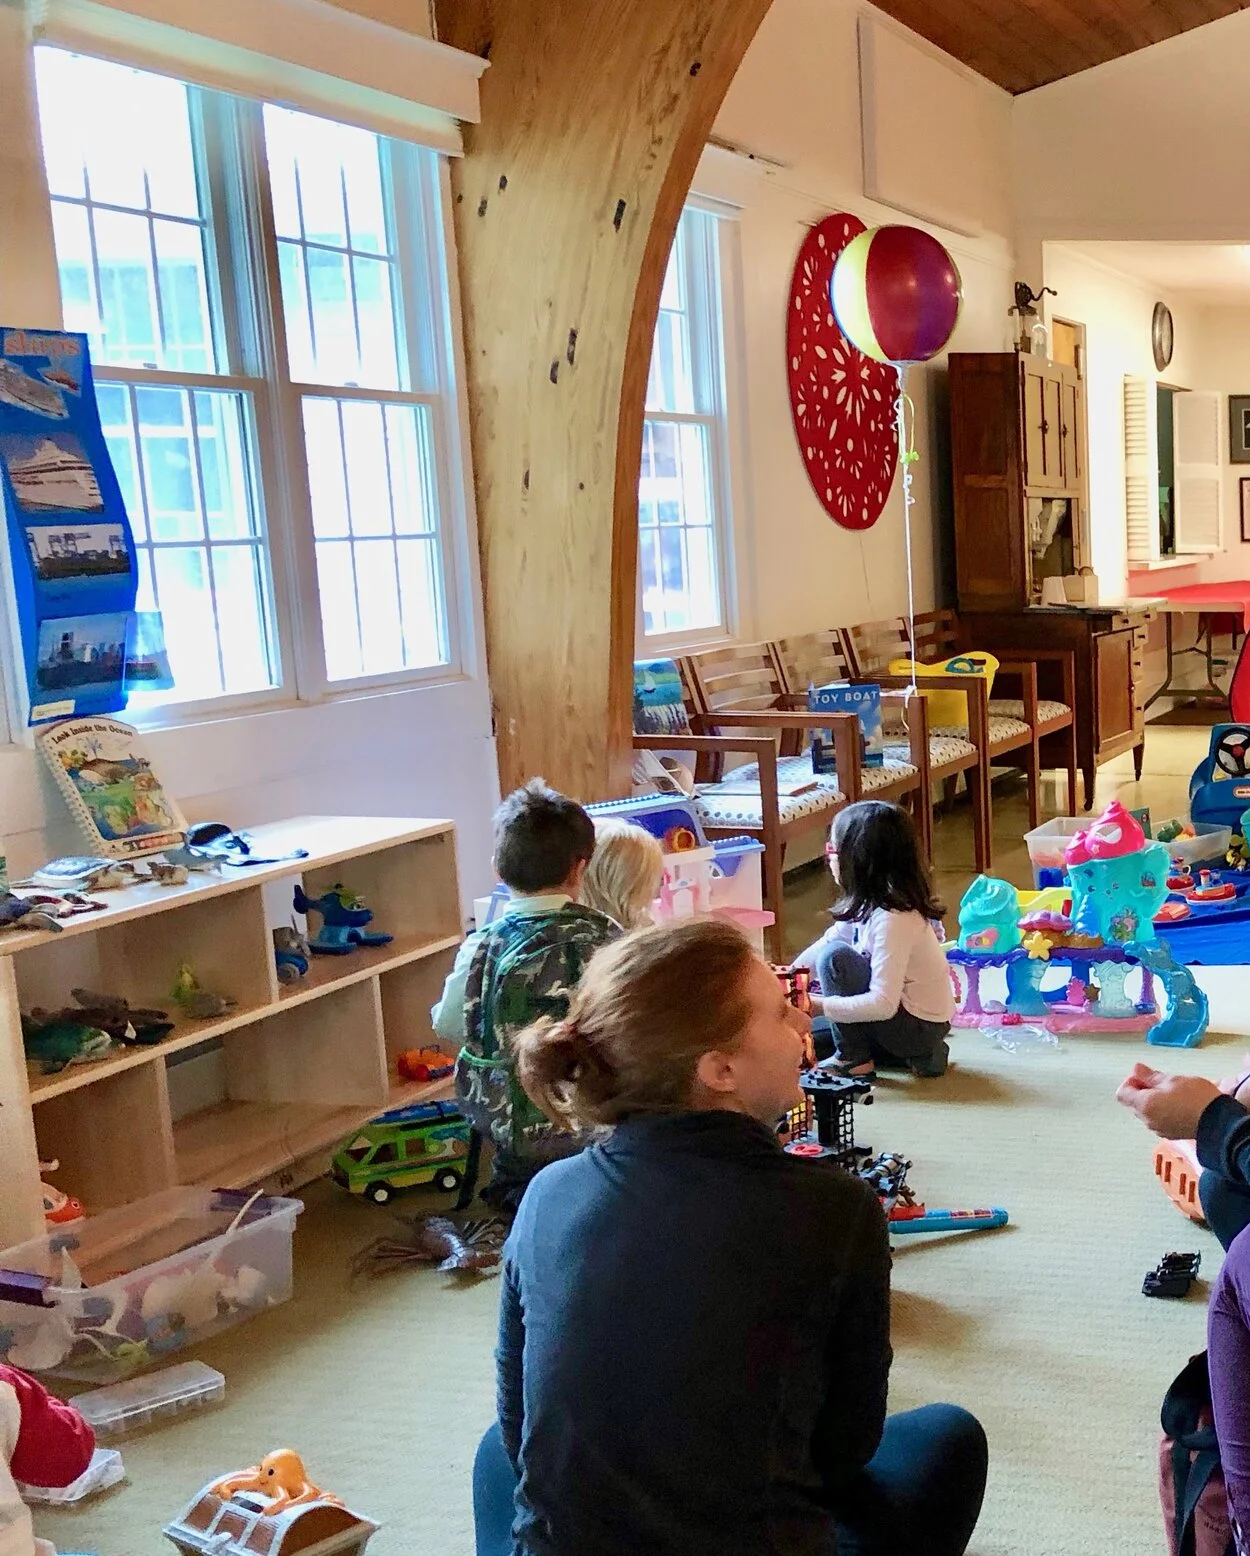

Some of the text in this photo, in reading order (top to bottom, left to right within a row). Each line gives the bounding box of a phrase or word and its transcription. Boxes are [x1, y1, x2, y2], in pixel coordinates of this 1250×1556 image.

[815, 690, 878, 704] TOY BOAT
[51, 724, 134, 745] Look Inside the Ocean
